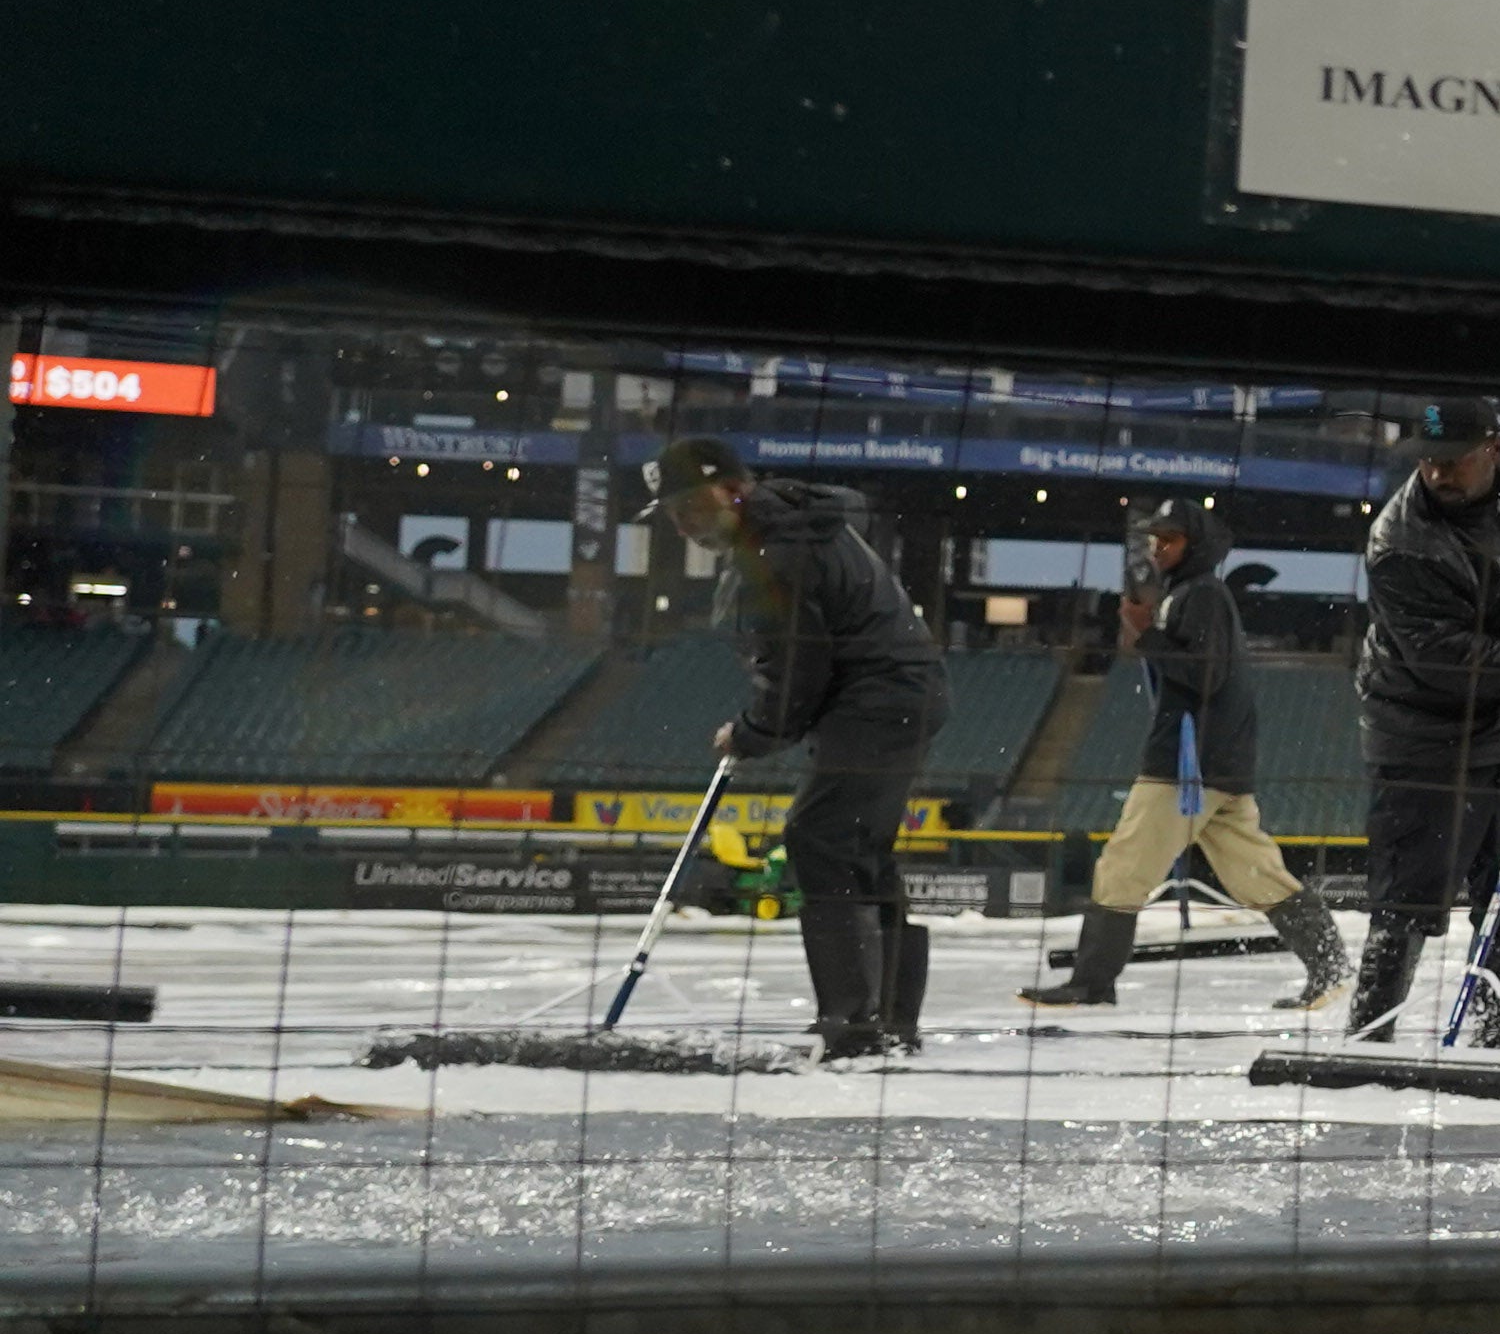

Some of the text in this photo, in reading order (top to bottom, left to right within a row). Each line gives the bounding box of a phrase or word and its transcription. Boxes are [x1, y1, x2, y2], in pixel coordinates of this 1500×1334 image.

[45, 365, 142, 403] $504
[864, 440, 944, 466] Banking
[449, 890, 576, 910] Companies
